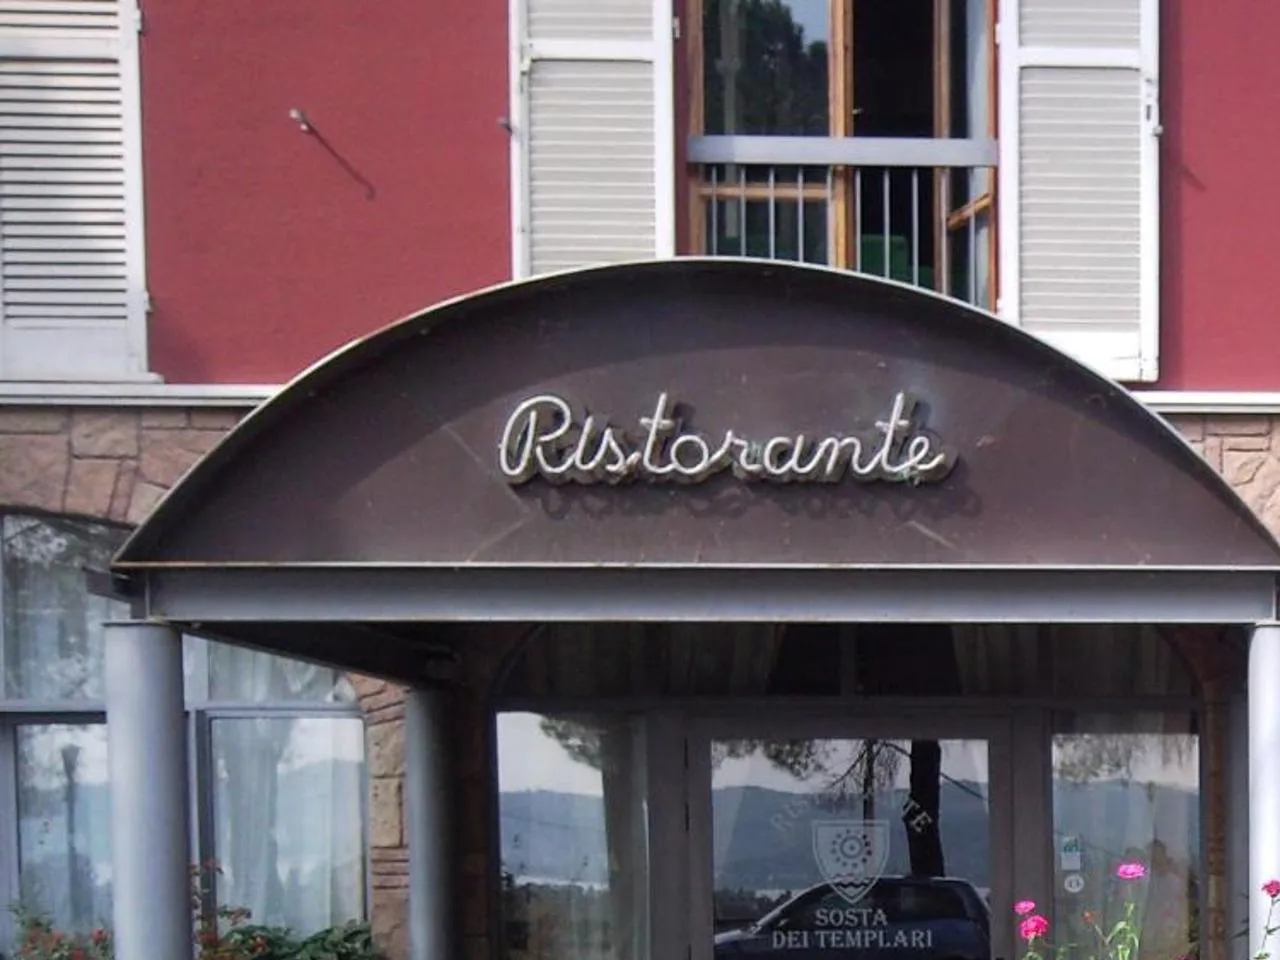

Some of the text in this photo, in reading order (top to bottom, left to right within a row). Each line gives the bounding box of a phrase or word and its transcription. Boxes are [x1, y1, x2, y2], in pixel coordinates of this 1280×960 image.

[499, 392, 948, 477] Ristorante
[815, 908, 888, 927] SOSTA
[772, 930, 933, 949] DEI TEMPLARI
